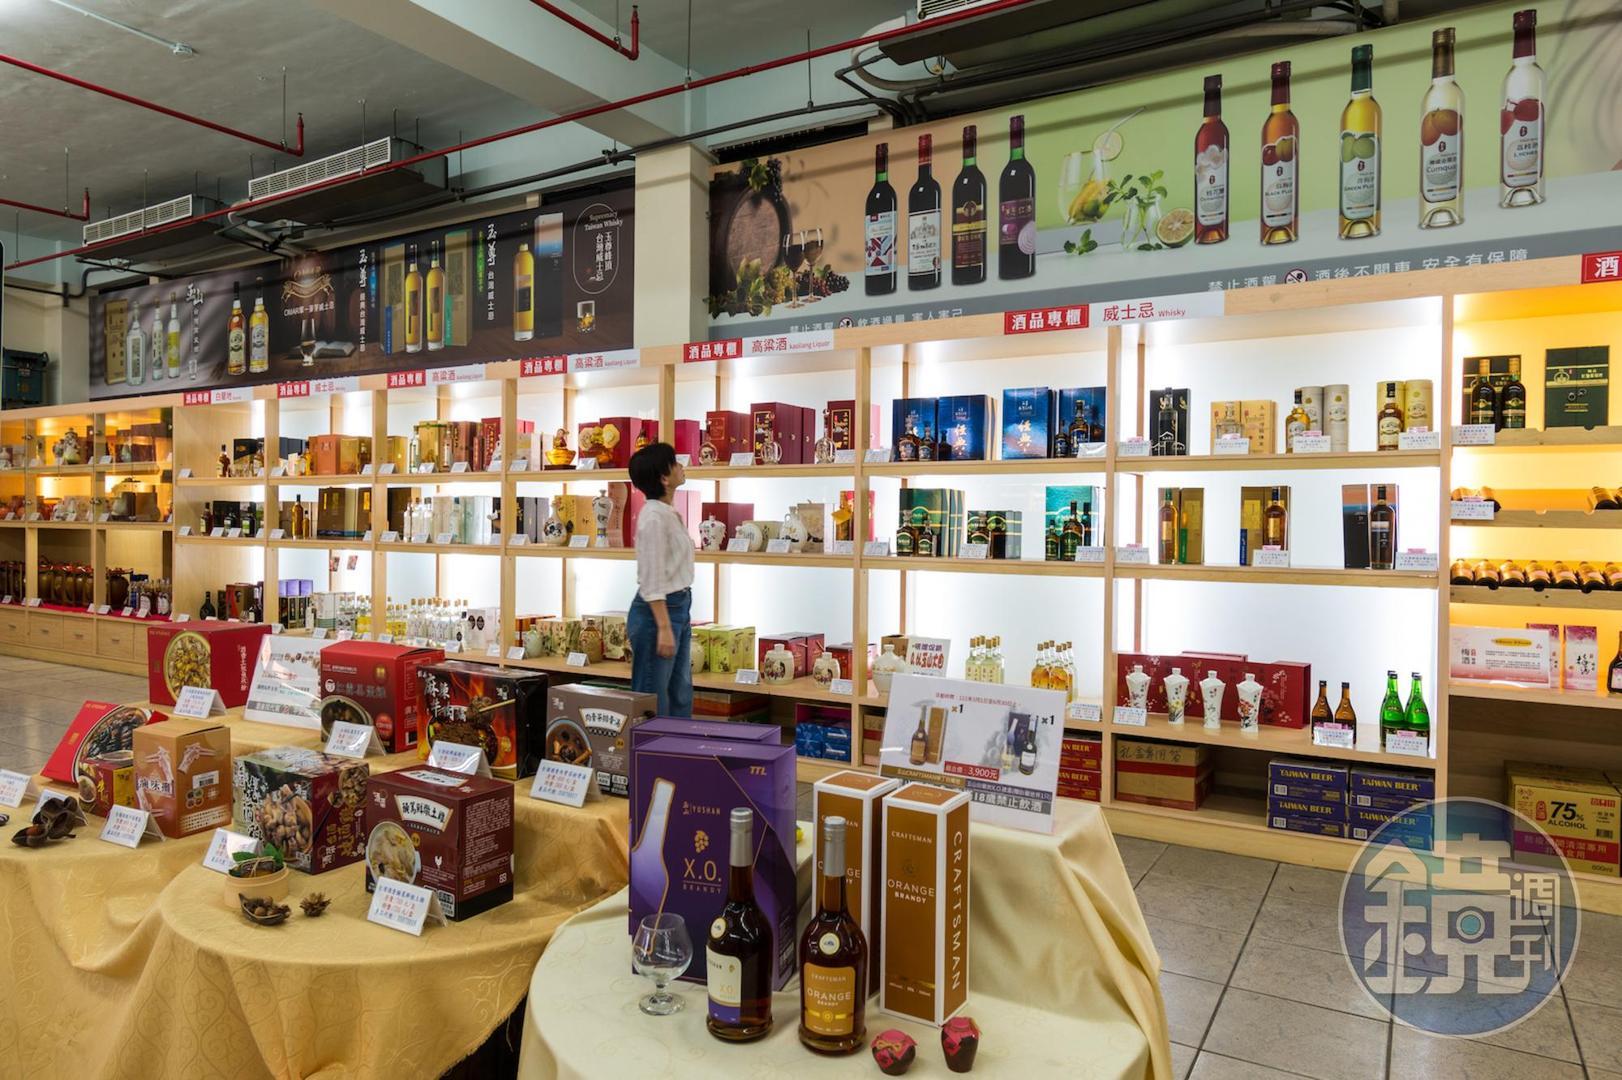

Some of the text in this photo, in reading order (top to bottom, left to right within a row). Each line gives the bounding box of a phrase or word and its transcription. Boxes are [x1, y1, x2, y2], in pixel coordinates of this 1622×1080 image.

[584, 218, 623, 231] Taiwan Whisky
[1011, 301, 1186, 331] 酒品專櫃 威士忌 Whisky
[688, 341, 737, 360] 酒品專櫃
[524, 358, 564, 374] 酒品專櫃
[1280, 768, 1334, 782] TAIWAN BEER
[1362, 777, 1420, 792] TAIWAN BEER
[1279, 801, 1333, 815] TAIWAN BEER
[1359, 811, 1417, 826] TAIWAN BEER
[1547, 819, 1588, 831] ALCOHOL
[891, 830, 932, 845] CRAFTSMAN
[887, 878, 935, 898] ORANGE
[894, 891, 927, 904] BRANDY
[952, 830, 963, 991] CRAFTSMAN
[811, 973, 847, 983] CRAFTSMAN
[807, 987, 851, 1001] ORANGE
[817, 999, 839, 1007] BRANDY
